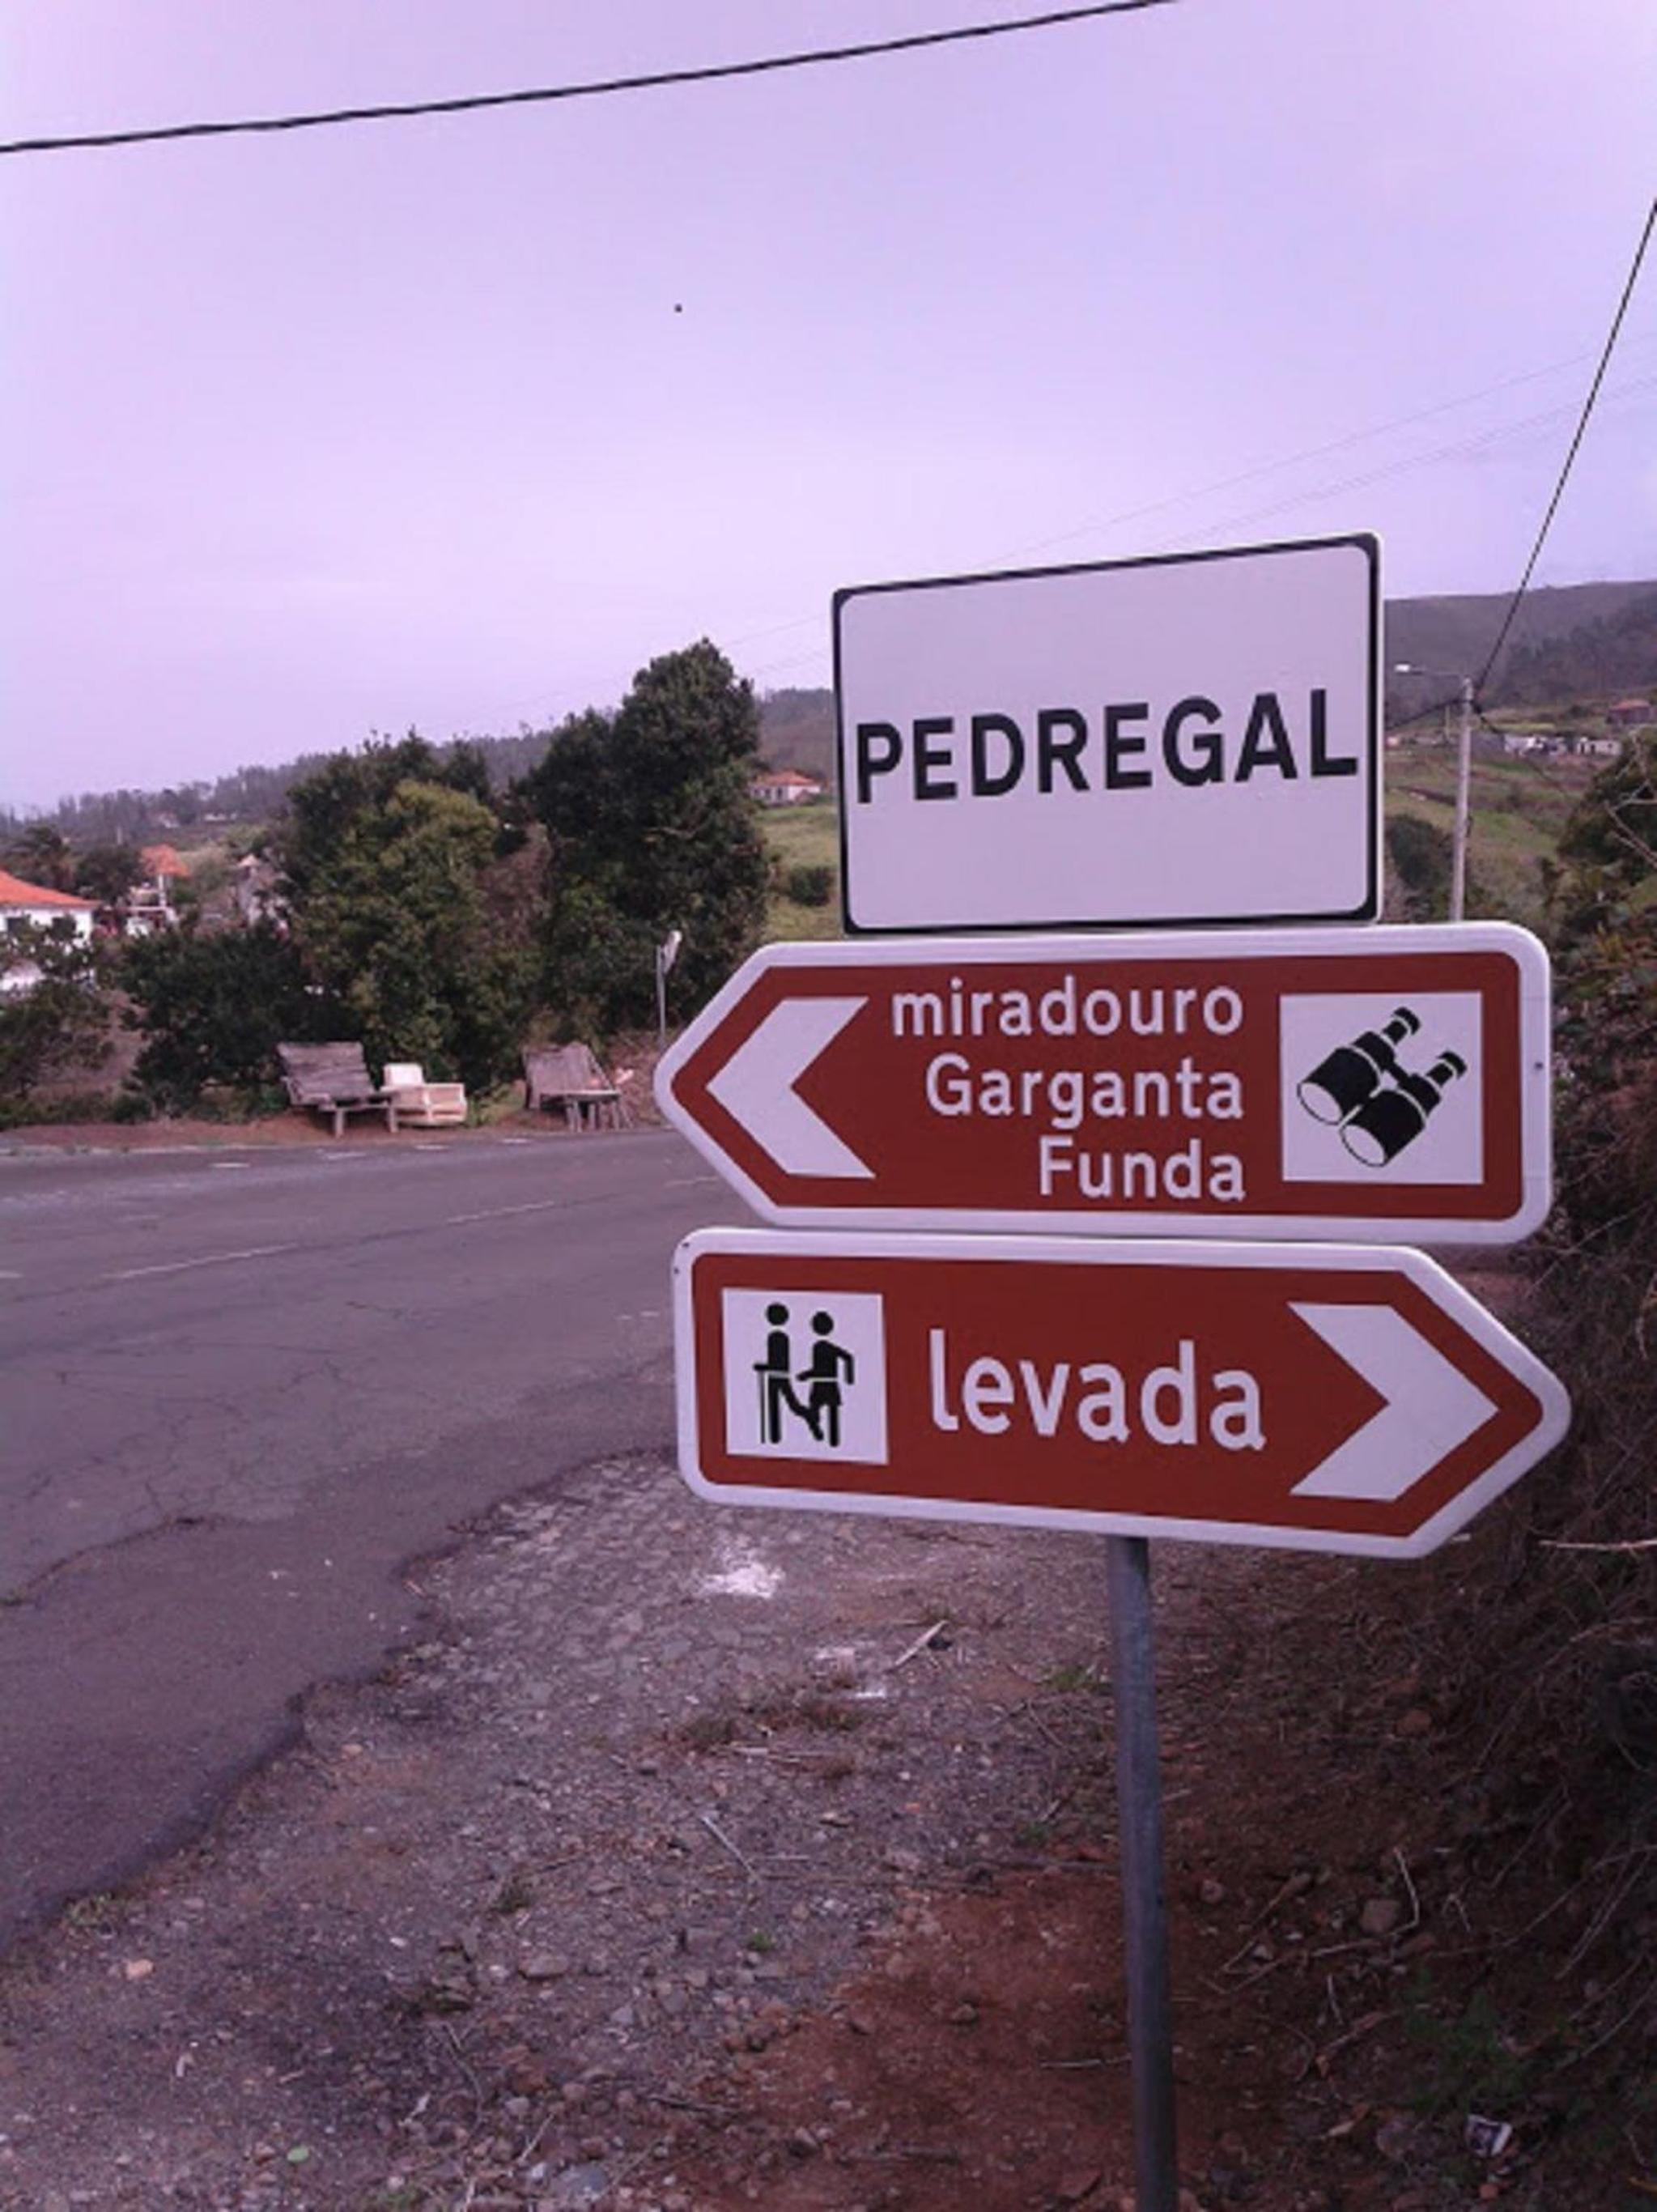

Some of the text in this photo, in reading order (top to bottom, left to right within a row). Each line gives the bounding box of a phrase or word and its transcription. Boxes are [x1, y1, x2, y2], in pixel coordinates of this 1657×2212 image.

[856, 688, 1360, 805] PEDREGAL
[892, 974, 1243, 1037] miradouro
[926, 1053, 1243, 1130] Garganta
[1039, 1135, 1246, 1202] Funda
[929, 1328, 1266, 1451] levada
